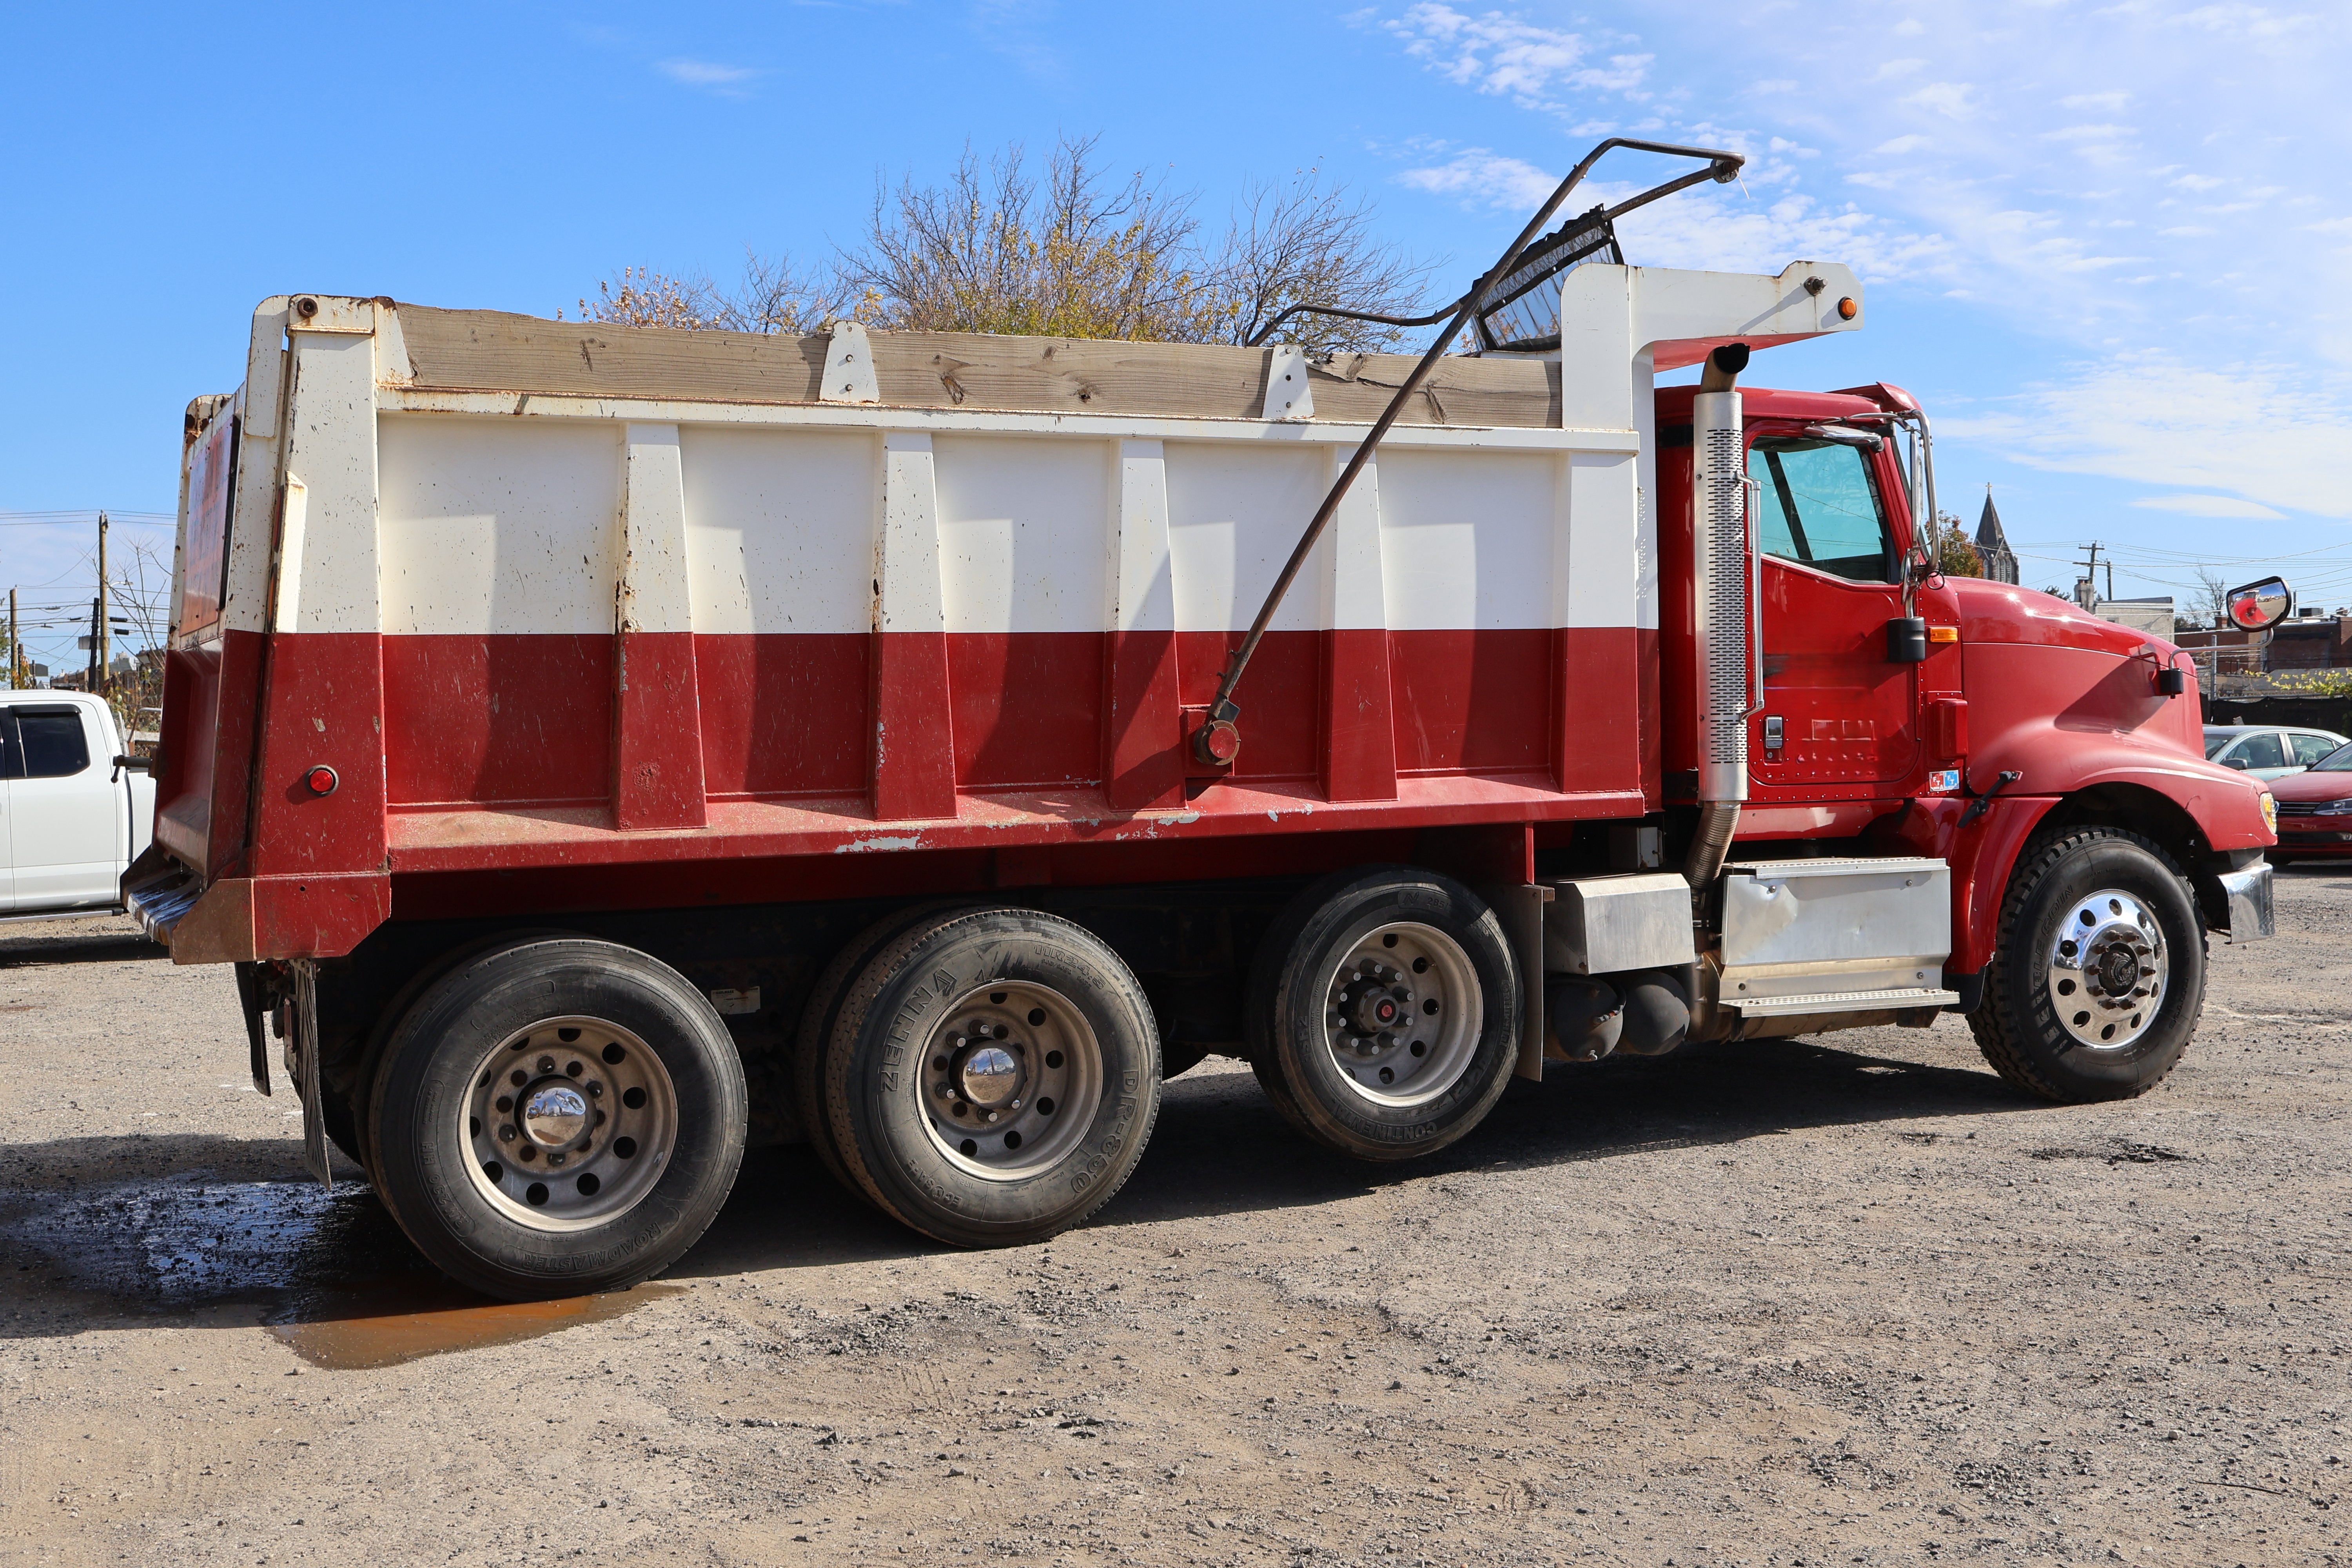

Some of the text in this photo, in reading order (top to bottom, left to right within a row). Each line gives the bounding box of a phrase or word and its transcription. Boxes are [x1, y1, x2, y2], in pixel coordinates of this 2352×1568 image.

[2042, 884, 2074, 936] COIN
[1034, 944, 1106, 990] 11R24.5
[646, 1000, 691, 1042] 11R24.5
[880, 967, 957, 1091] ZENNA
[1499, 979, 1512, 1047] Continental
[421, 1141, 436, 1165] HH
[1071, 1069, 1139, 1193] DR-850
[428, 1173, 453, 1206] 230
[907, 1158, 963, 1206] ECOSAFE
[521, 1220, 662, 1272] ROADMASTER
